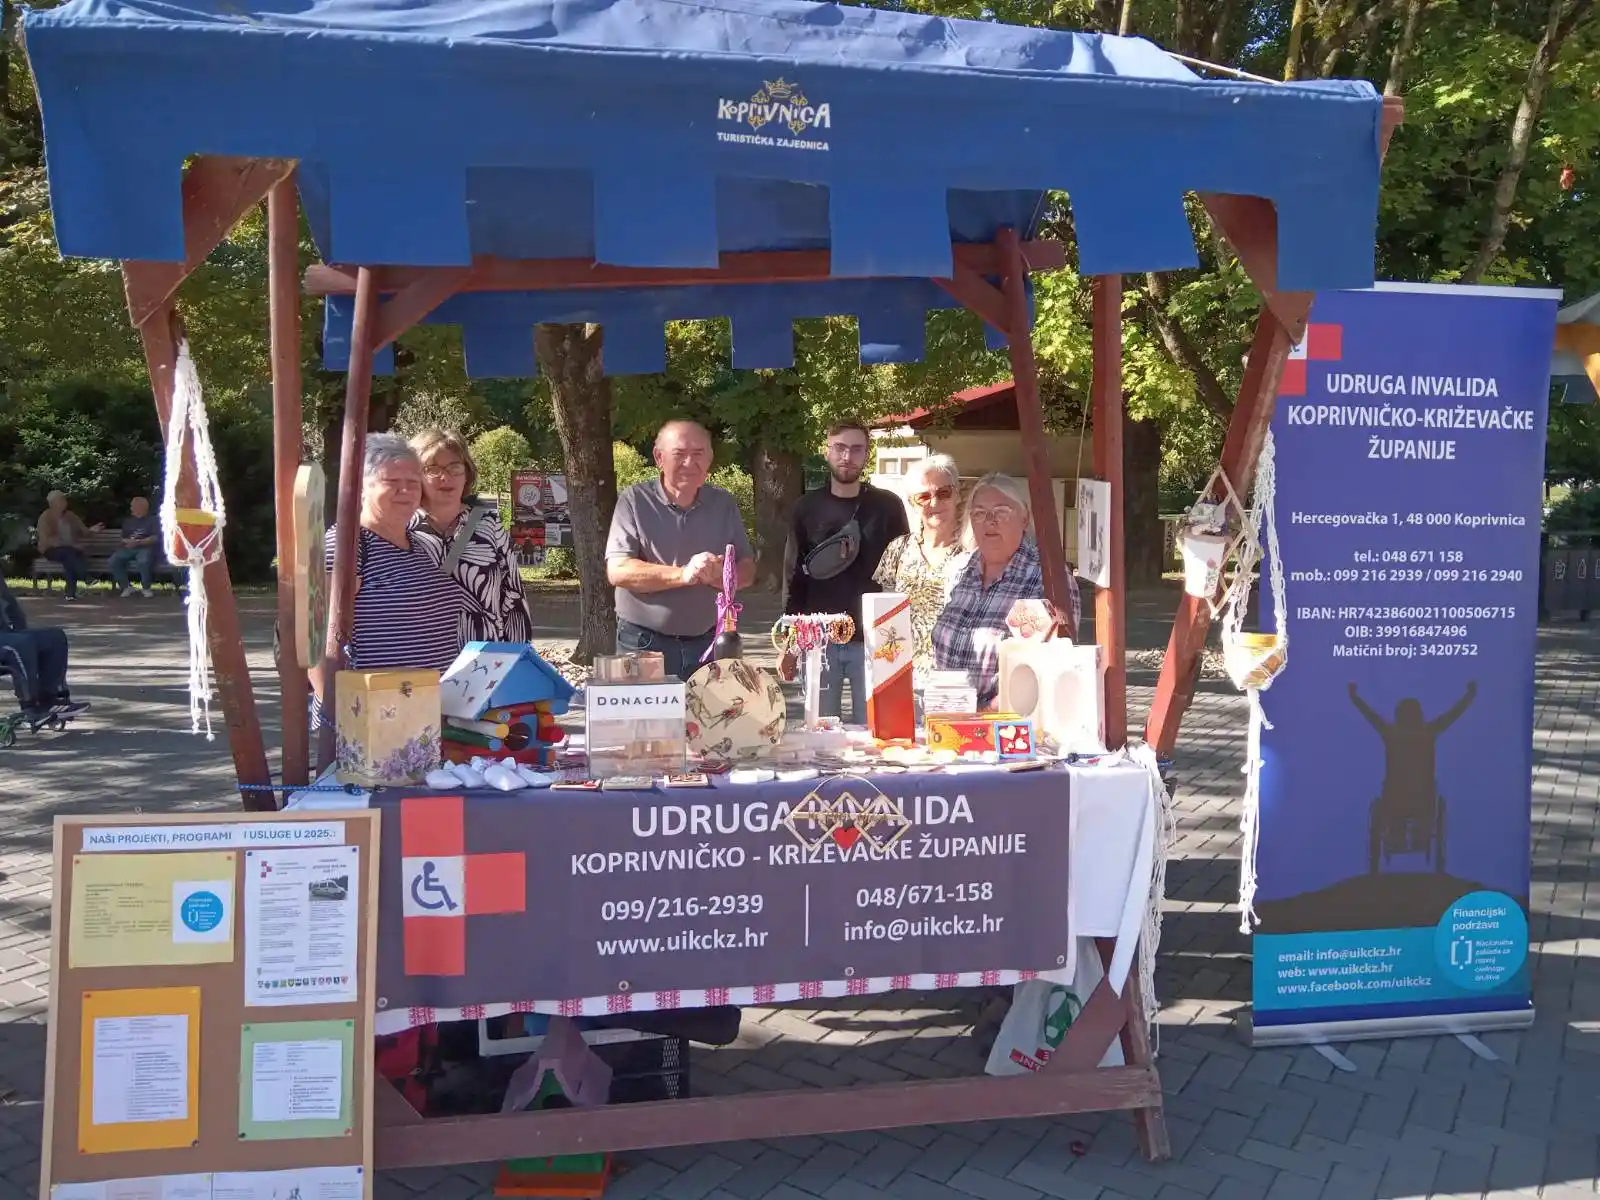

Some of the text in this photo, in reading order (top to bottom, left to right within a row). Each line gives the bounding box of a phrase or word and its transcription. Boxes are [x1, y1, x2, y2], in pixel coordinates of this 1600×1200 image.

[717, 132, 829, 151] TURISTIČKA ZAJEDNICA
[1327, 373, 1499, 398] UDRUGA INVALIDA
[1288, 403, 1534, 430] KOPRIVNIČKO-KRIŽEVAČKE
[1368, 435, 1456, 460] ŽUPANIJE
[1291, 511, 1526, 529] Hercegovačka 1, 48 000 Koprivnica
[1353, 551, 1463, 563] tel.: 048 671 158
[1291, 569, 1523, 583] mob.: 099 216 2939 / 099 216 2940
[1297, 607, 1515, 620] IBAN: HR7423860021100506715
[1344, 625, 1467, 638] OIB: 39916847496
[1332, 643, 1478, 659] Matični broj: 3420752
[632, 801, 797, 837] UDRUGA
[89, 833, 115, 844] NAŠI
[118, 832, 169, 844] PROJEKTI,
[172, 831, 232, 843] PROGRAMI
[249, 830, 292, 839] USLUGE
[294, 830, 302, 838] U
[571, 843, 745, 875] KOPRIVNIČKO
[769, 835, 913, 866] KRIŽEVAČKE
[919, 833, 1027, 858] ŽUPANIJE
[856, 882, 993, 909] 048/671-158
[601, 895, 763, 922] 099/216-2939
[844, 914, 1004, 941] info@uikckz.hr
[597, 928, 768, 956] www.uikckz.hr
[1278, 946, 1402, 963] email: info@uikckz.hr
[1277, 962, 1394, 979] web: www.uikckz.hr
[1277, 976, 1432, 994] www.facebook.com/uikckz
